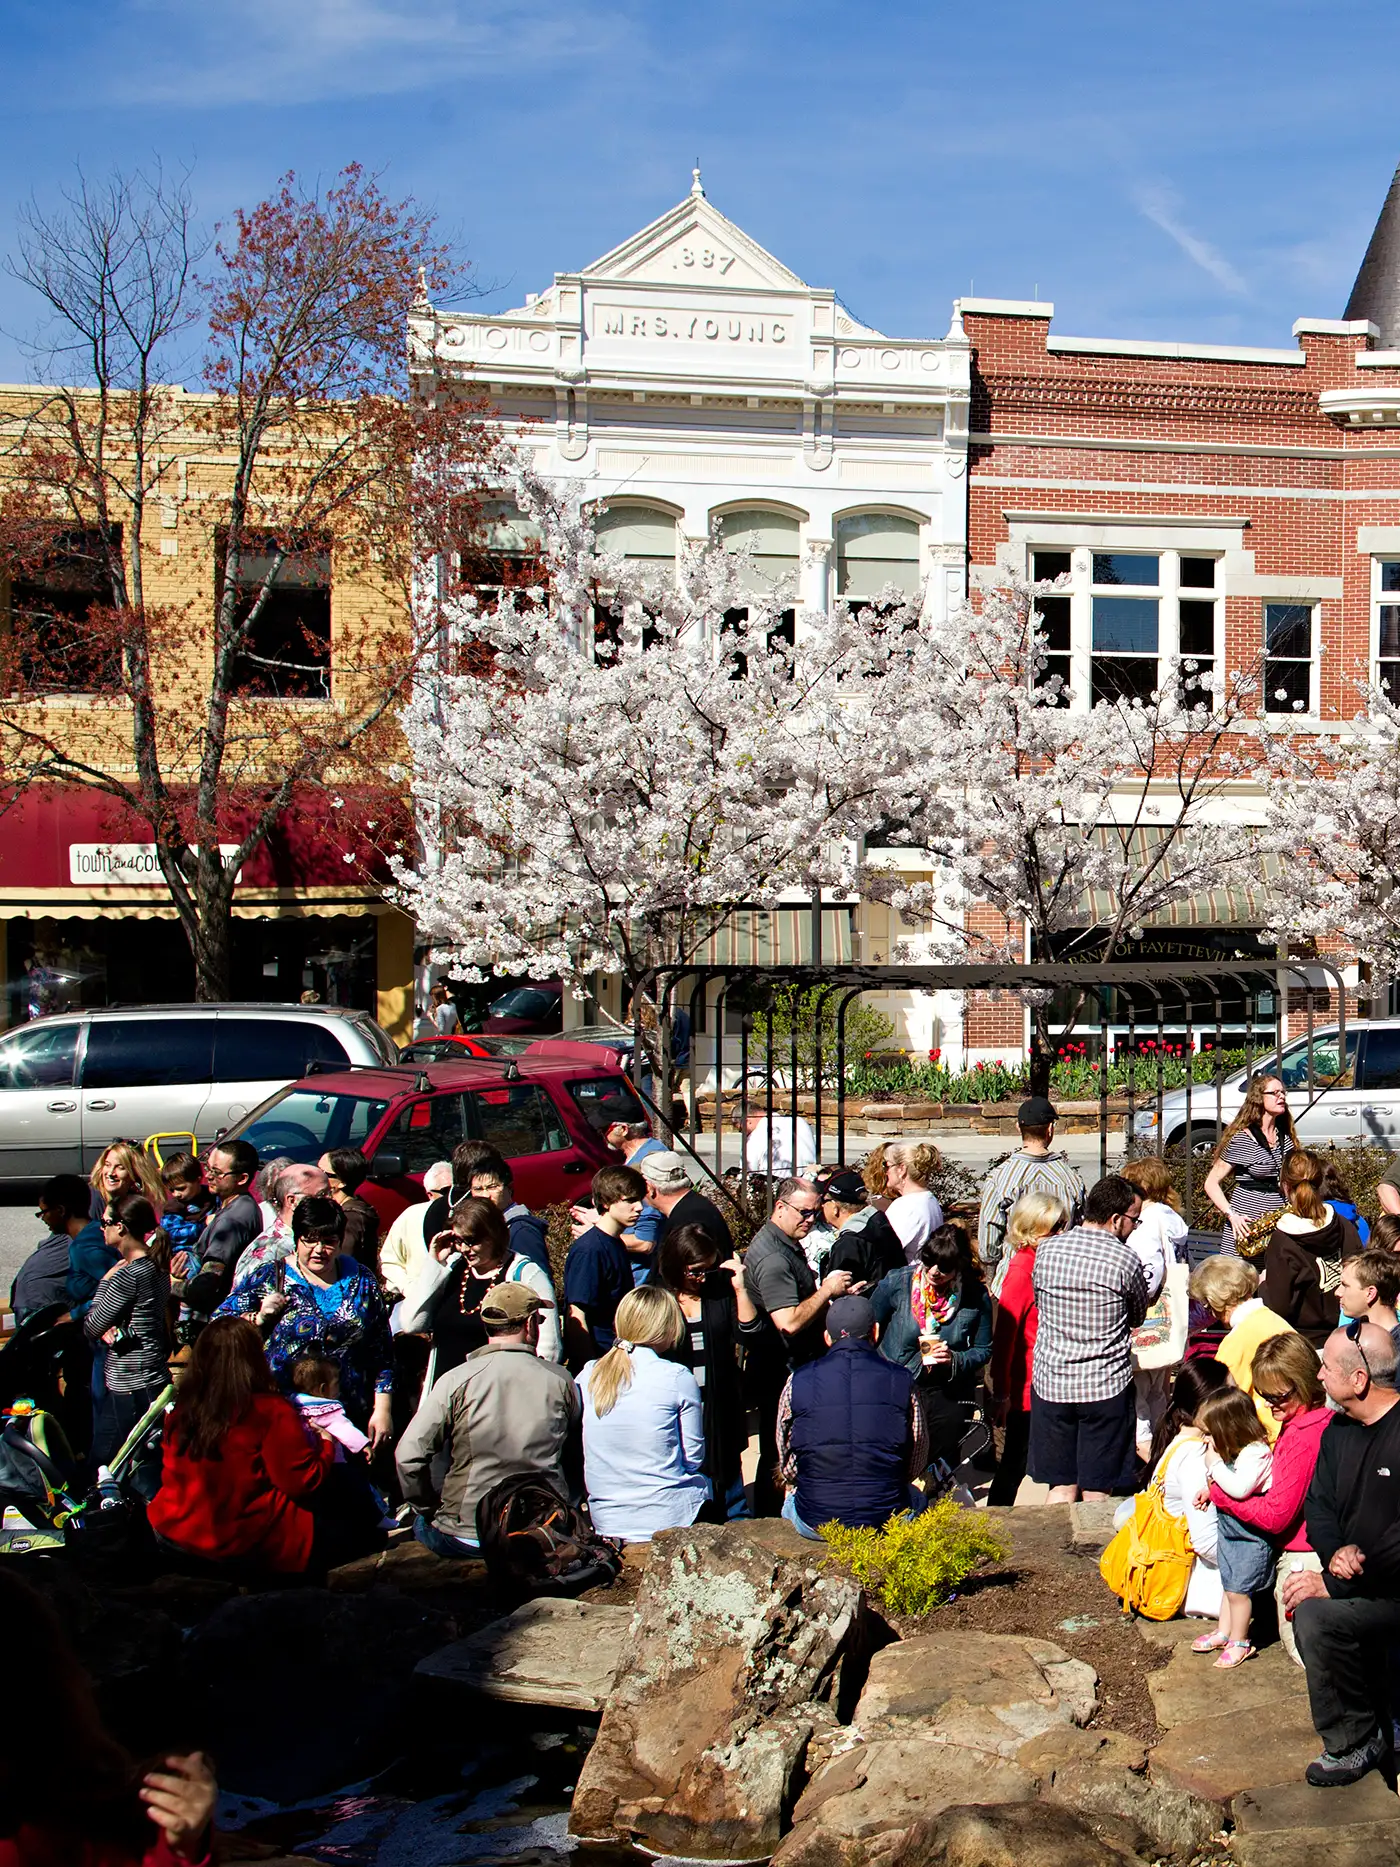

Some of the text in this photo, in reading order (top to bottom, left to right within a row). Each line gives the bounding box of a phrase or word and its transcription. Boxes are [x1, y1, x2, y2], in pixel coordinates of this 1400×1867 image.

[687, 317, 786, 343] YOUNG
[76, 850, 112, 872] town
[1114, 942, 1136, 956] OF
